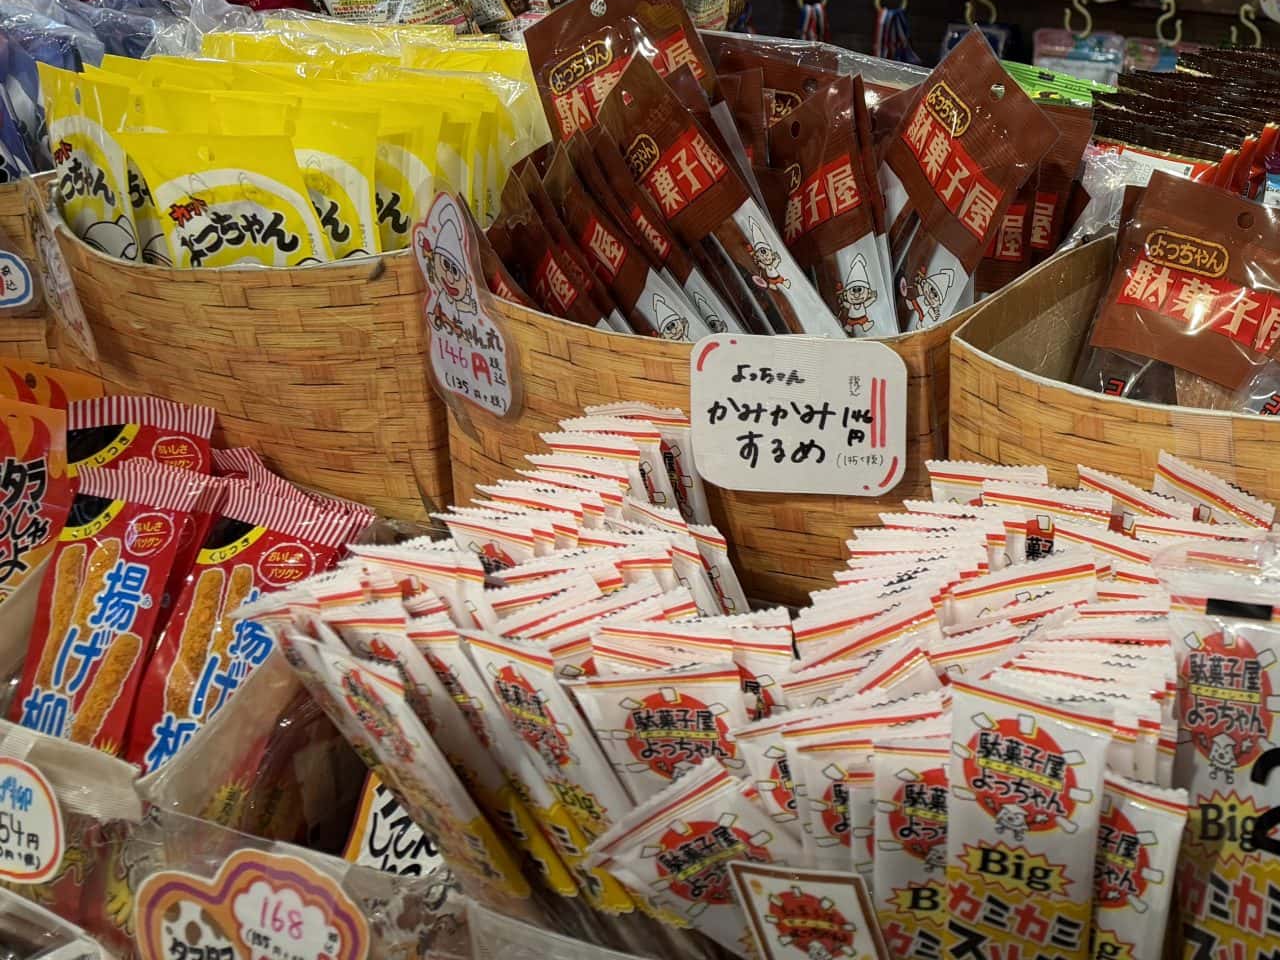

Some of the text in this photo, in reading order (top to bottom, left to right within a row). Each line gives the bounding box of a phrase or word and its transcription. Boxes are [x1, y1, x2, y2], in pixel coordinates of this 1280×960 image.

[907, 106, 998, 236] 駄菓子屋
[168, 197, 209, 228] カット
[1149, 236, 1226, 275] よっちゃん
[731, 364, 806, 386] よっちゃん
[707, 396, 837, 430] かみかみ
[842, 406, 875, 428] 146
[736, 431, 827, 469] するめ
[847, 429, 866, 447] 円
[1188, 653, 1262, 692] 駄菓子屋
[632, 706, 717, 732] 駄菓子屋
[1187, 695, 1266, 734] よっちゃん
[640, 737, 729, 760] よっちゃん
[977, 731, 1068, 780] 駄菓子屋
[971, 767, 1067, 815] よっちゃん
[1200, 803, 1262, 853] Big
[657, 825, 740, 874] 駄菓子屋
[976, 846, 1055, 892] Big
[260, 897, 304, 941] 168
[948, 881, 1082, 950] カミカミ
